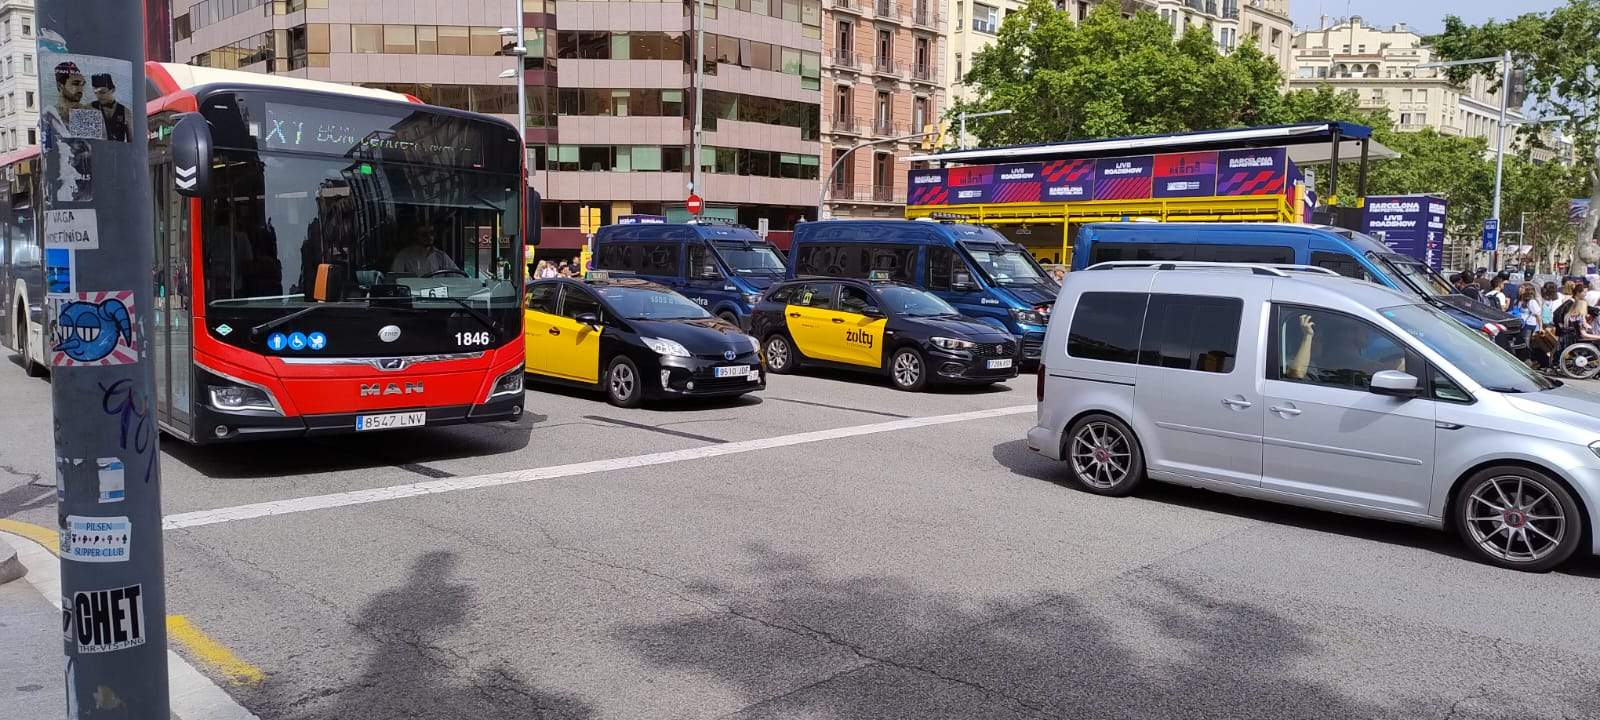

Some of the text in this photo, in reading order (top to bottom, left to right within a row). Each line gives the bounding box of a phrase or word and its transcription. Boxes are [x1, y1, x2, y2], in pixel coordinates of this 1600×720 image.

[1104, 167, 1143, 175] ROADSHOW
[455, 332, 490, 346] 1846
[360, 381, 425, 397] MAN
[365, 414, 423, 428] 8547 LNV
[86, 522, 112, 531] PILSEN
[74, 547, 125, 557] SUPPER CLUB
[75, 584, 141, 646] CHET
